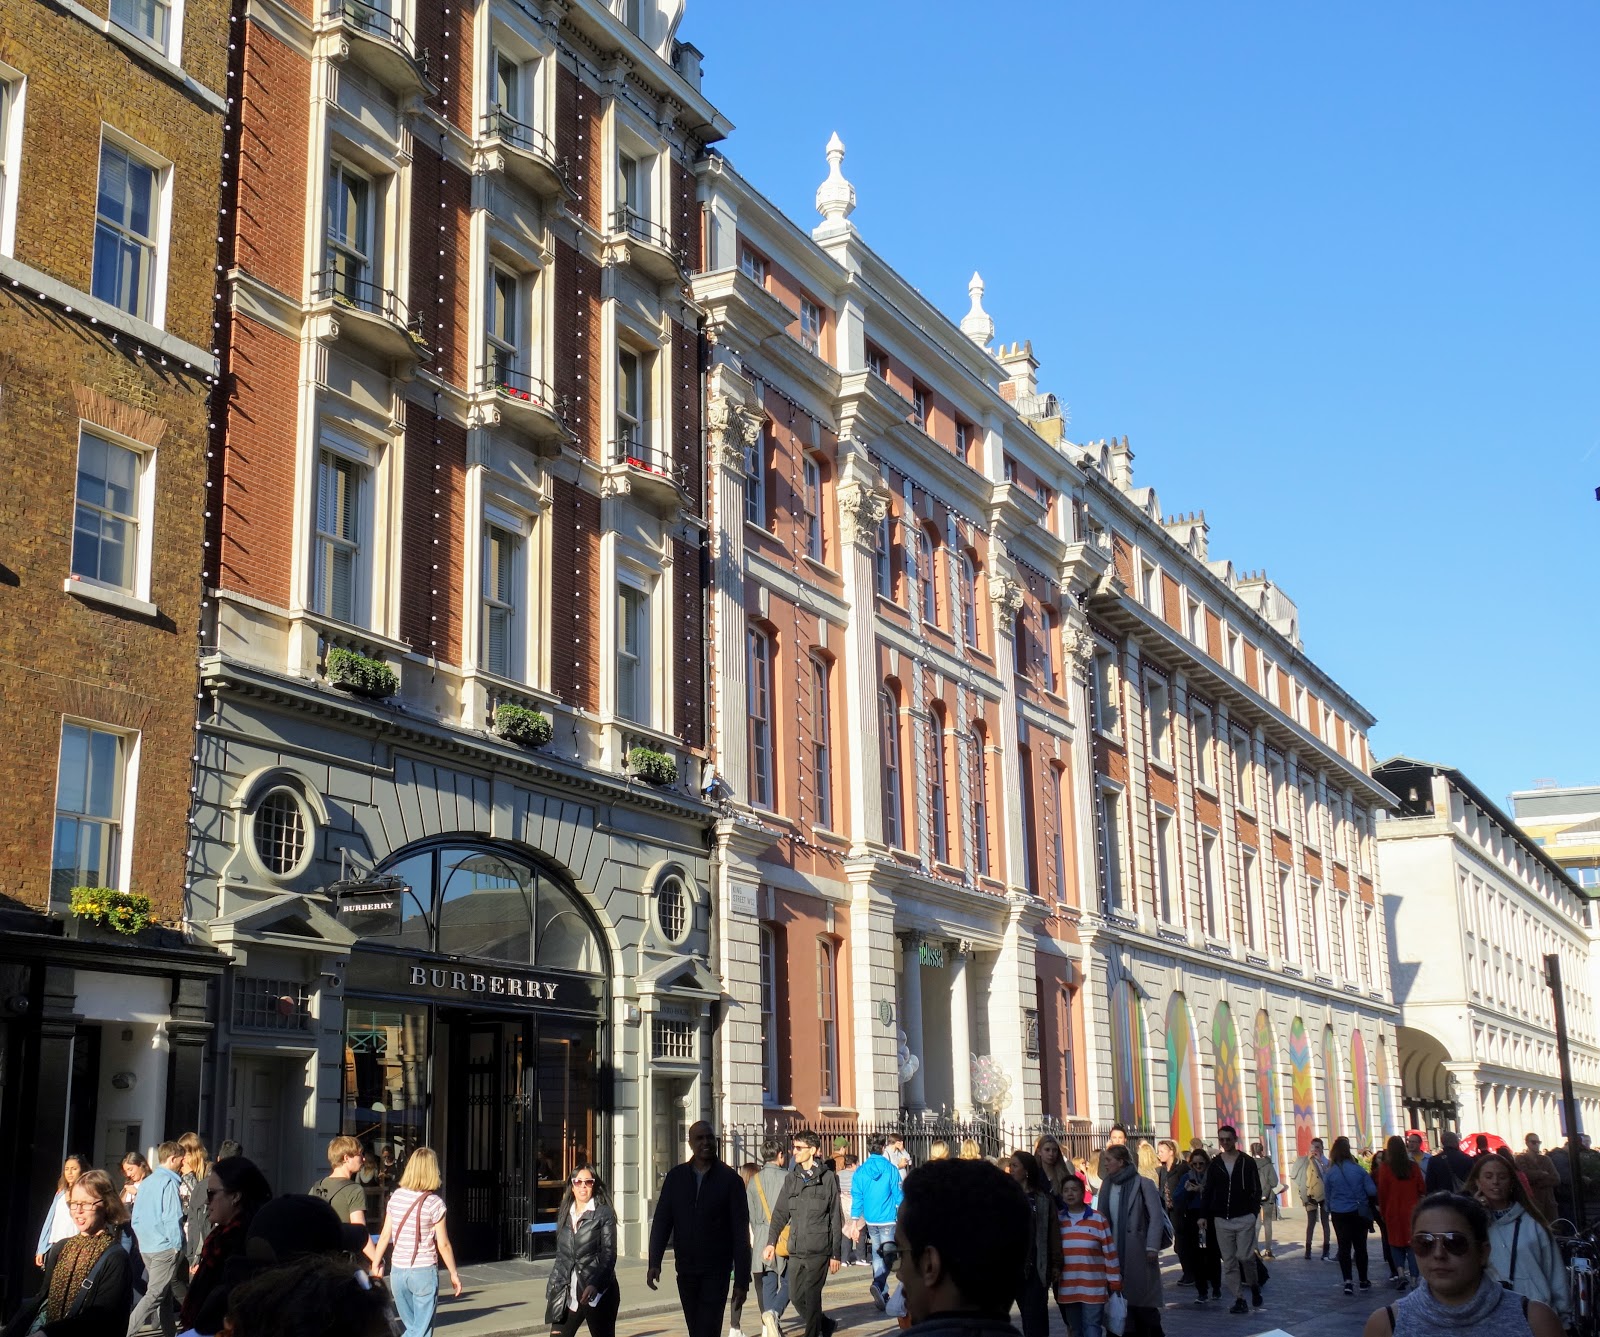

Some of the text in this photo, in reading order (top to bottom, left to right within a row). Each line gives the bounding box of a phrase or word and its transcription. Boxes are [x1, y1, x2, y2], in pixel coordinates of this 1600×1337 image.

[732, 886, 742, 894] KING
[732, 894, 755, 906] STREET WC2
[343, 902, 393, 912] BURBERRY
[409, 966, 559, 1000] BURBERRY
